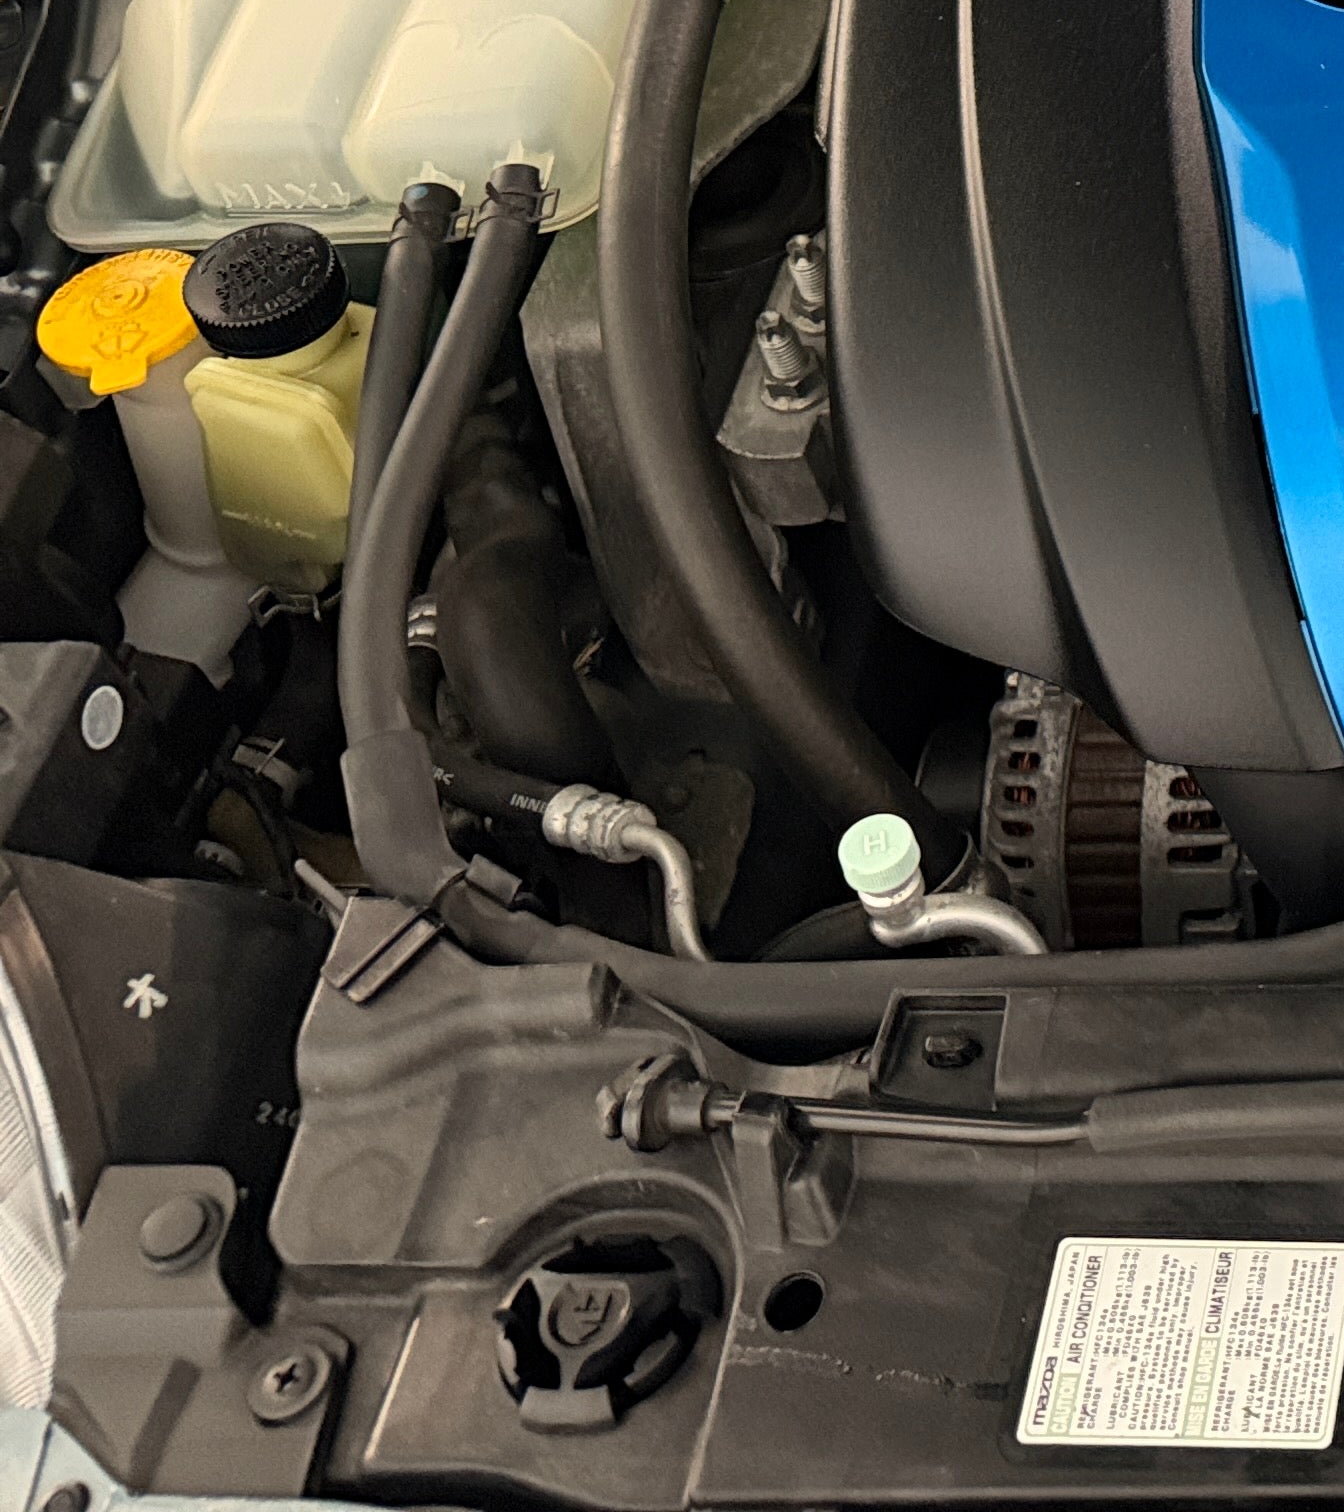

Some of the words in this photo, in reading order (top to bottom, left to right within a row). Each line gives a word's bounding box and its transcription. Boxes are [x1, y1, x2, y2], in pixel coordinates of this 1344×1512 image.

[217, 182, 327, 209] MAX
[863, 829, 888, 856] H
[1071, 1255, 1103, 1338] CONDITIONER
[1031, 1356, 1058, 1425] mazda
[1065, 1251, 1080, 1285] JAPAN
[1065, 1342, 1084, 1363] AIR
[1190, 1384, 1209, 1402] EN
[1204, 1251, 1234, 1333] CLIMATISEUR
[1049, 1376, 1077, 1432] CAUTION
